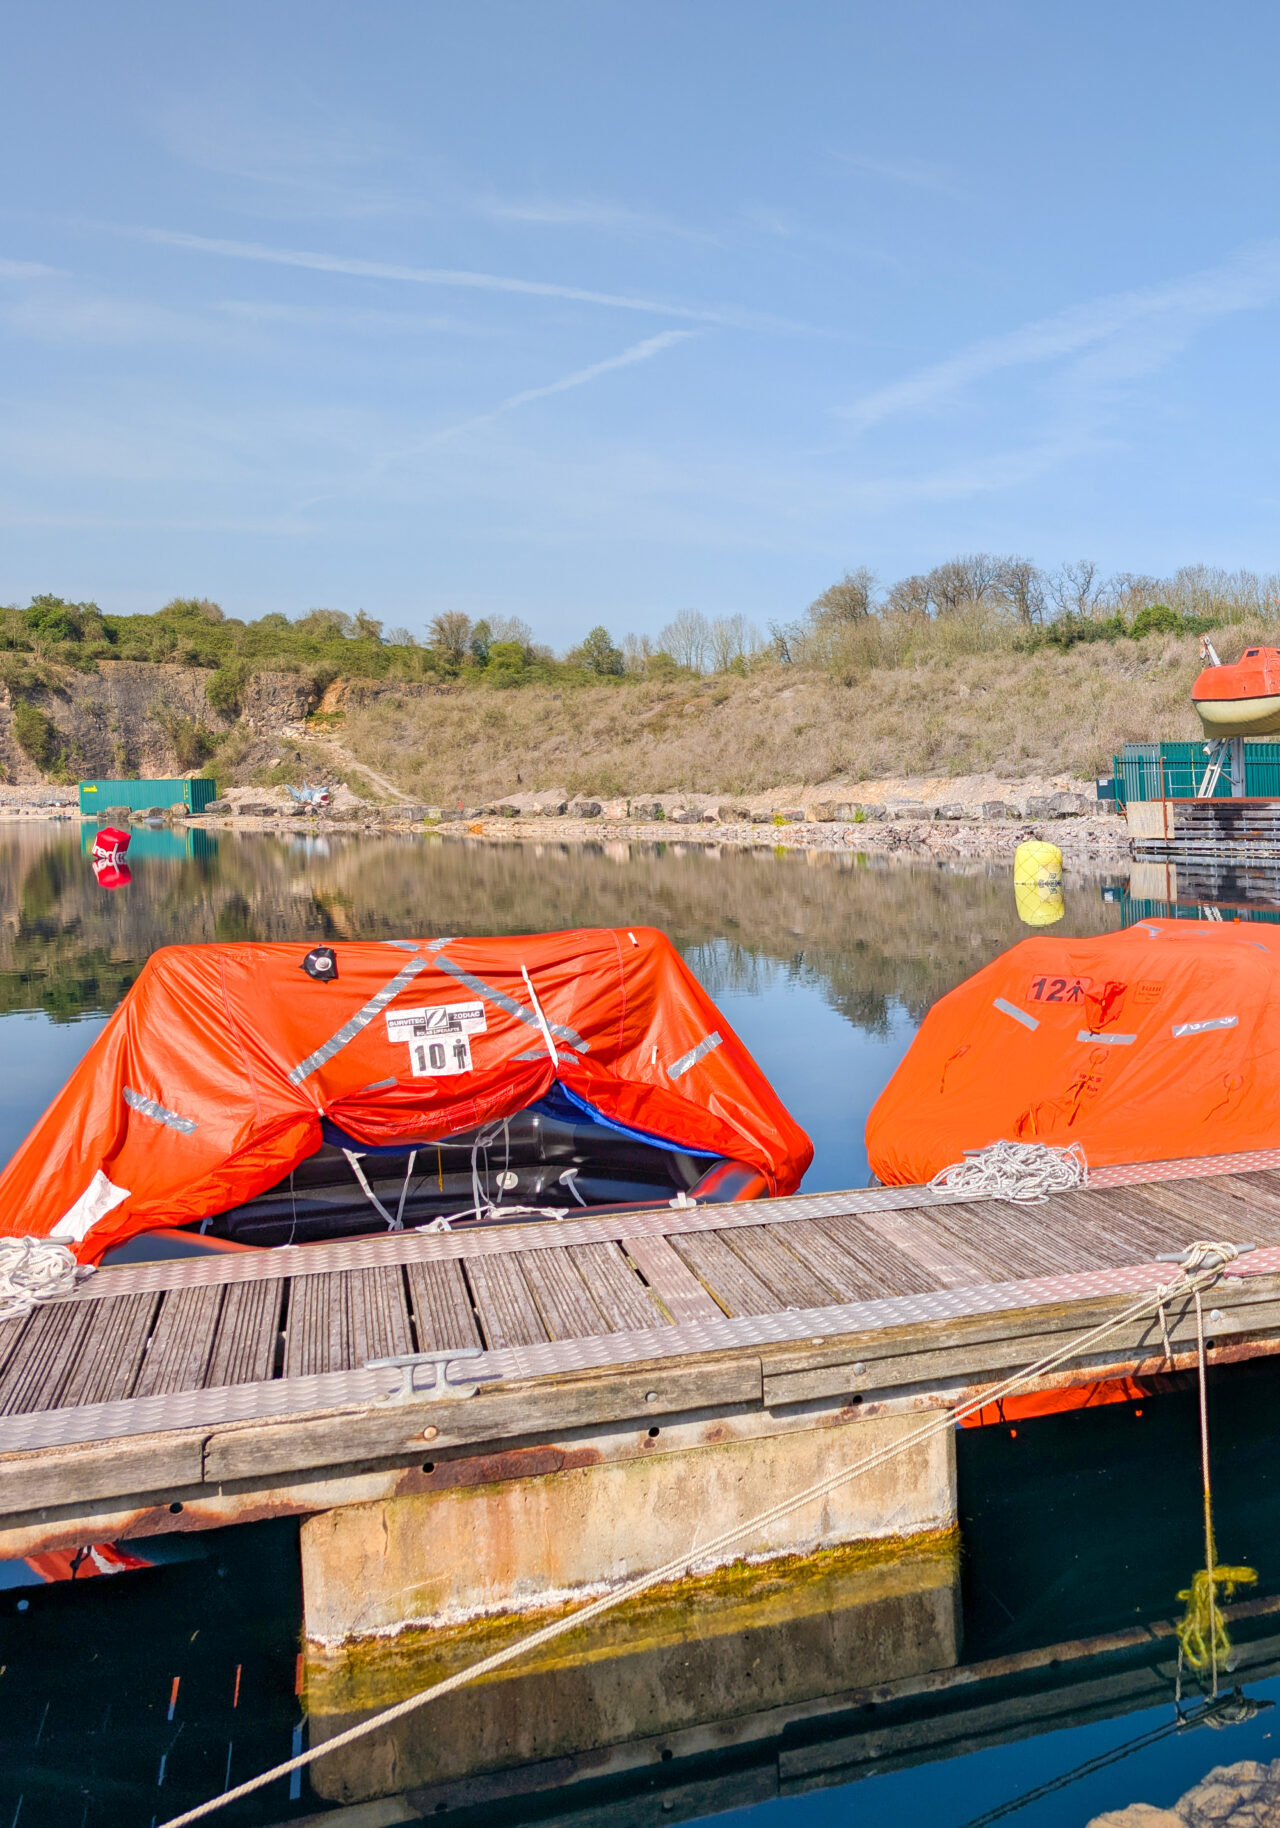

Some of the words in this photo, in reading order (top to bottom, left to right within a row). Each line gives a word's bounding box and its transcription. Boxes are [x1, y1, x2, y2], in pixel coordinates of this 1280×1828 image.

[1032, 978, 1067, 1002] 12
[388, 1018, 425, 1027] SURVITEC
[453, 1011, 481, 1020] ZODIAC
[415, 1043, 447, 1072] 10
